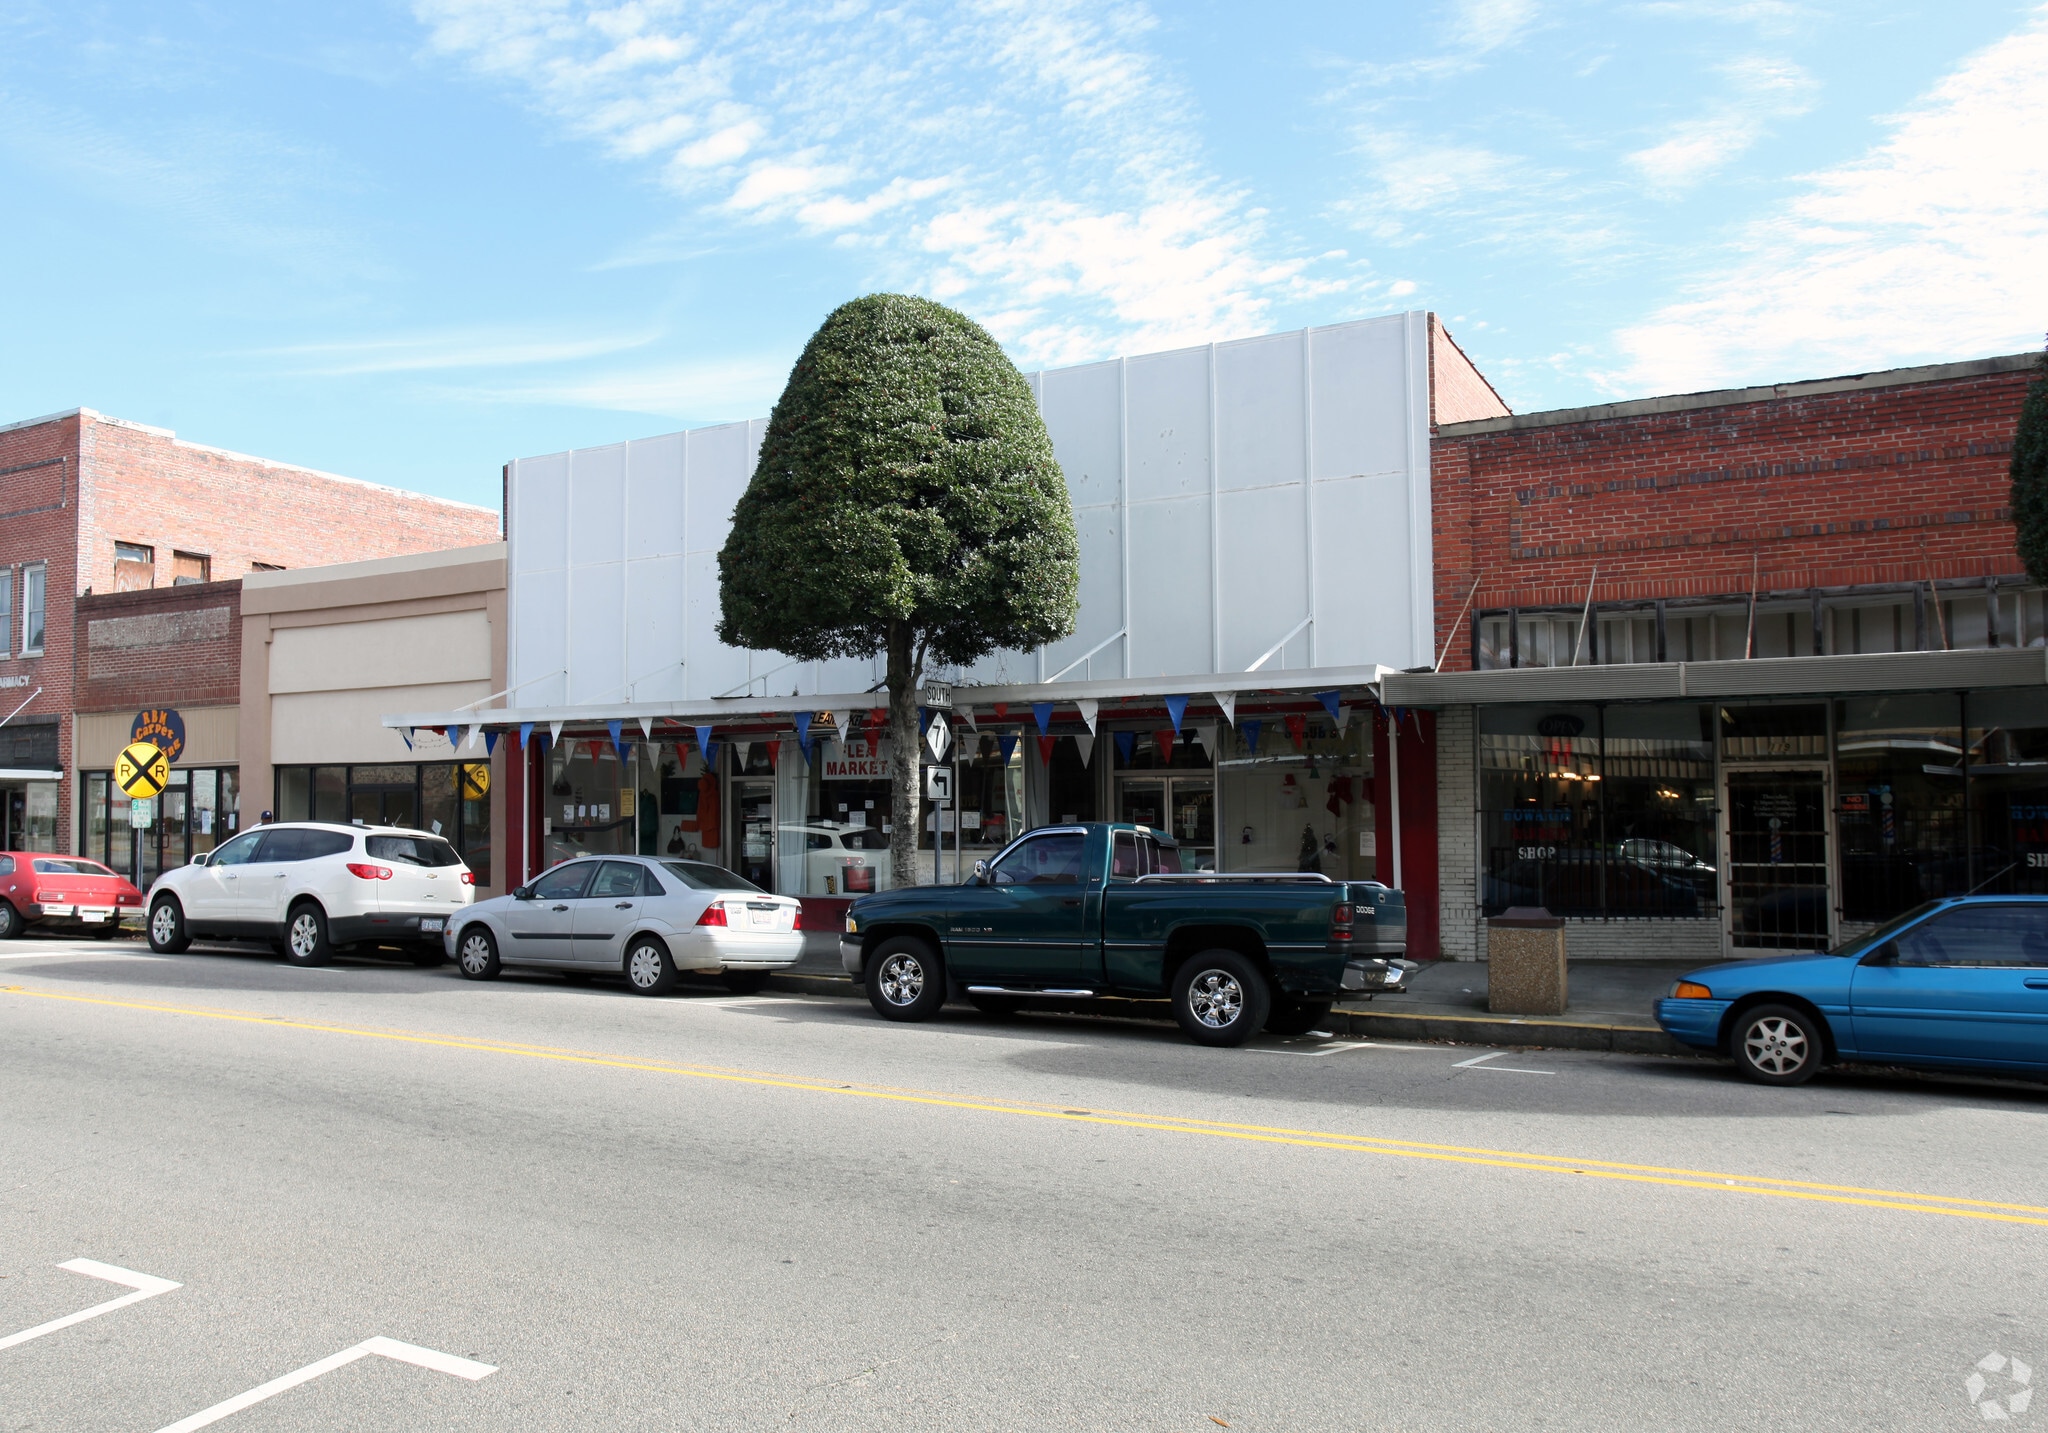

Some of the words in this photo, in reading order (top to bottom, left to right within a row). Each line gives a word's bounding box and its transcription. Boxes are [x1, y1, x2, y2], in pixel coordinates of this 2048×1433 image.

[927, 686, 951, 702] SOUTH
[142, 709, 168, 725] RBM
[136, 724, 174, 740] Carpet
[1543, 719, 1577, 735] OPEN
[933, 724, 946, 749] 71
[843, 744, 877, 758] LE
[121, 764, 131, 777] R
[155, 765, 165, 778] R
[826, 761, 888, 776] MARKET
[1518, 846, 1556, 860] SHOP
[1355, 905, 1375, 915] DODGE
